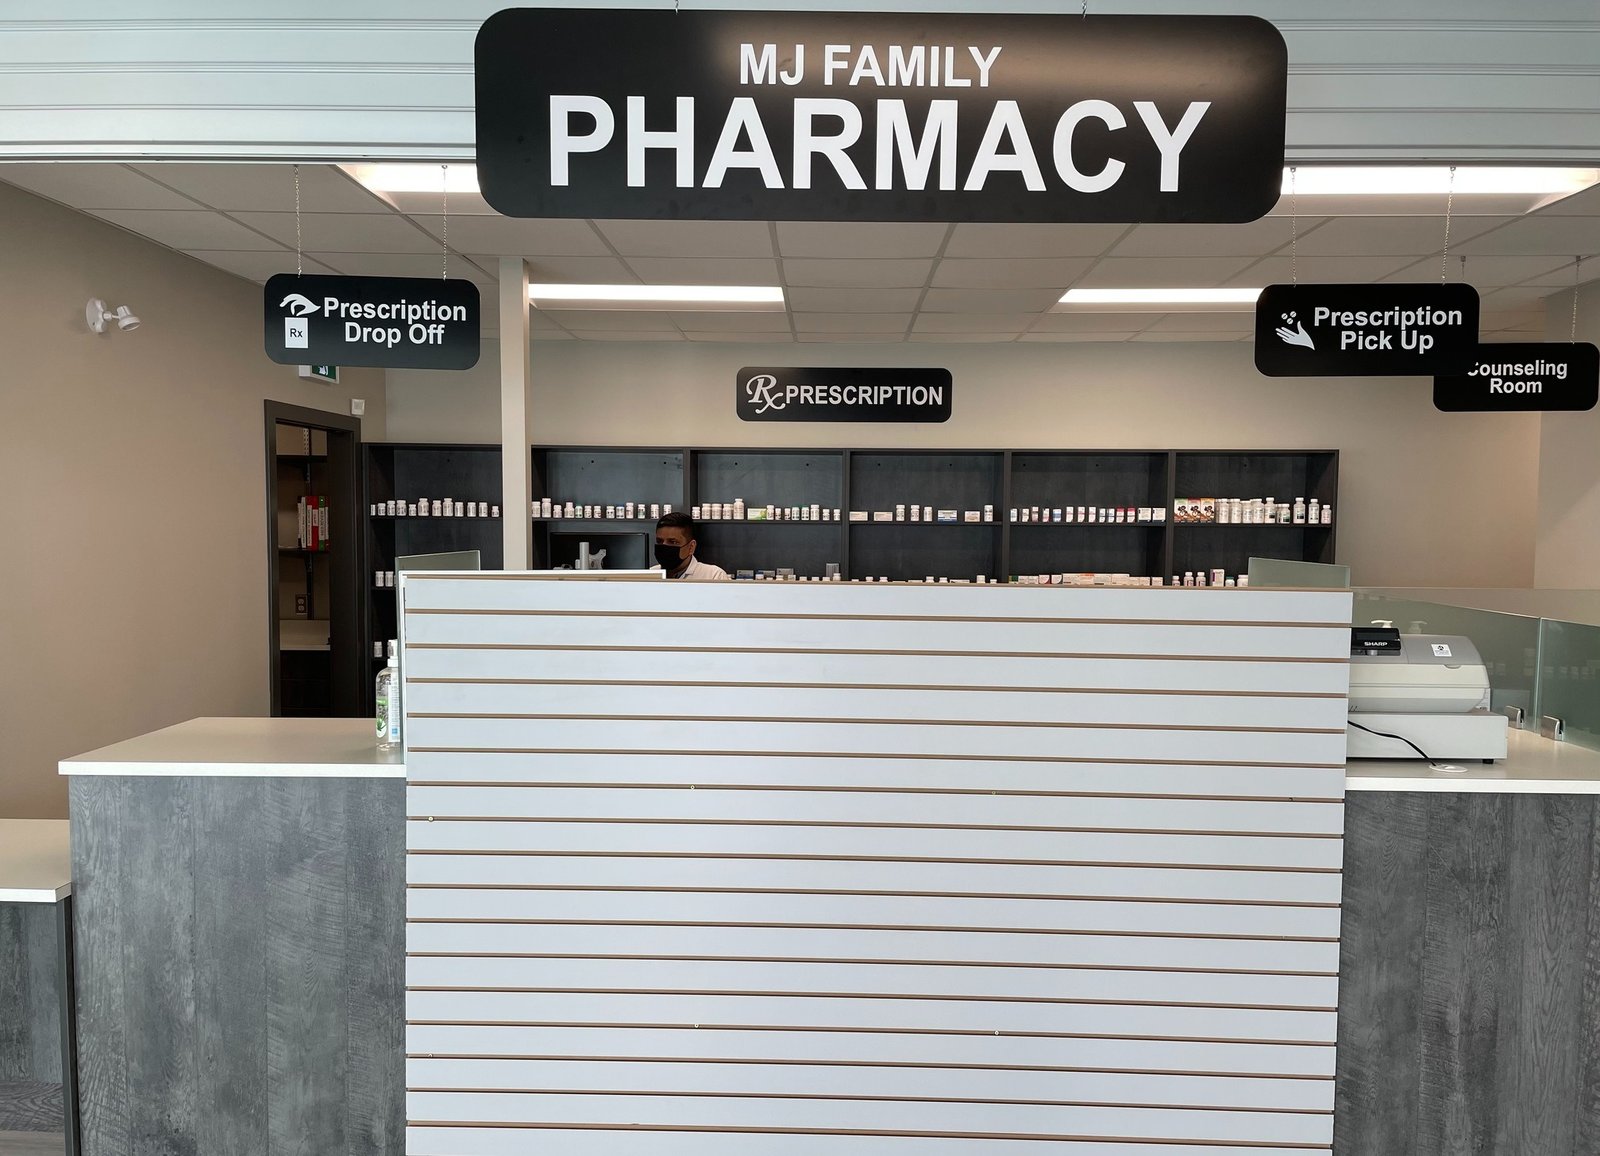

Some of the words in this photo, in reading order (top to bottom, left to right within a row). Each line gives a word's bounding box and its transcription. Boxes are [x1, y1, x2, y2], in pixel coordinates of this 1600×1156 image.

[740, 43, 805, 86] MJ
[824, 44, 1003, 88] FAMILY
[548, 94, 1212, 194] PHARMACY
[323, 296, 467, 325] Prescription
[1313, 306, 1462, 332] Prescription
[289, 328, 303, 339] Rx
[344, 321, 402, 349] Drop
[408, 323, 446, 345] Off
[1340, 330, 1393, 350] Pick
[1400, 330, 1434, 355] Up
[785, 385, 943, 406] PRESCRIPTION
[1490, 377, 1542, 394] Room
